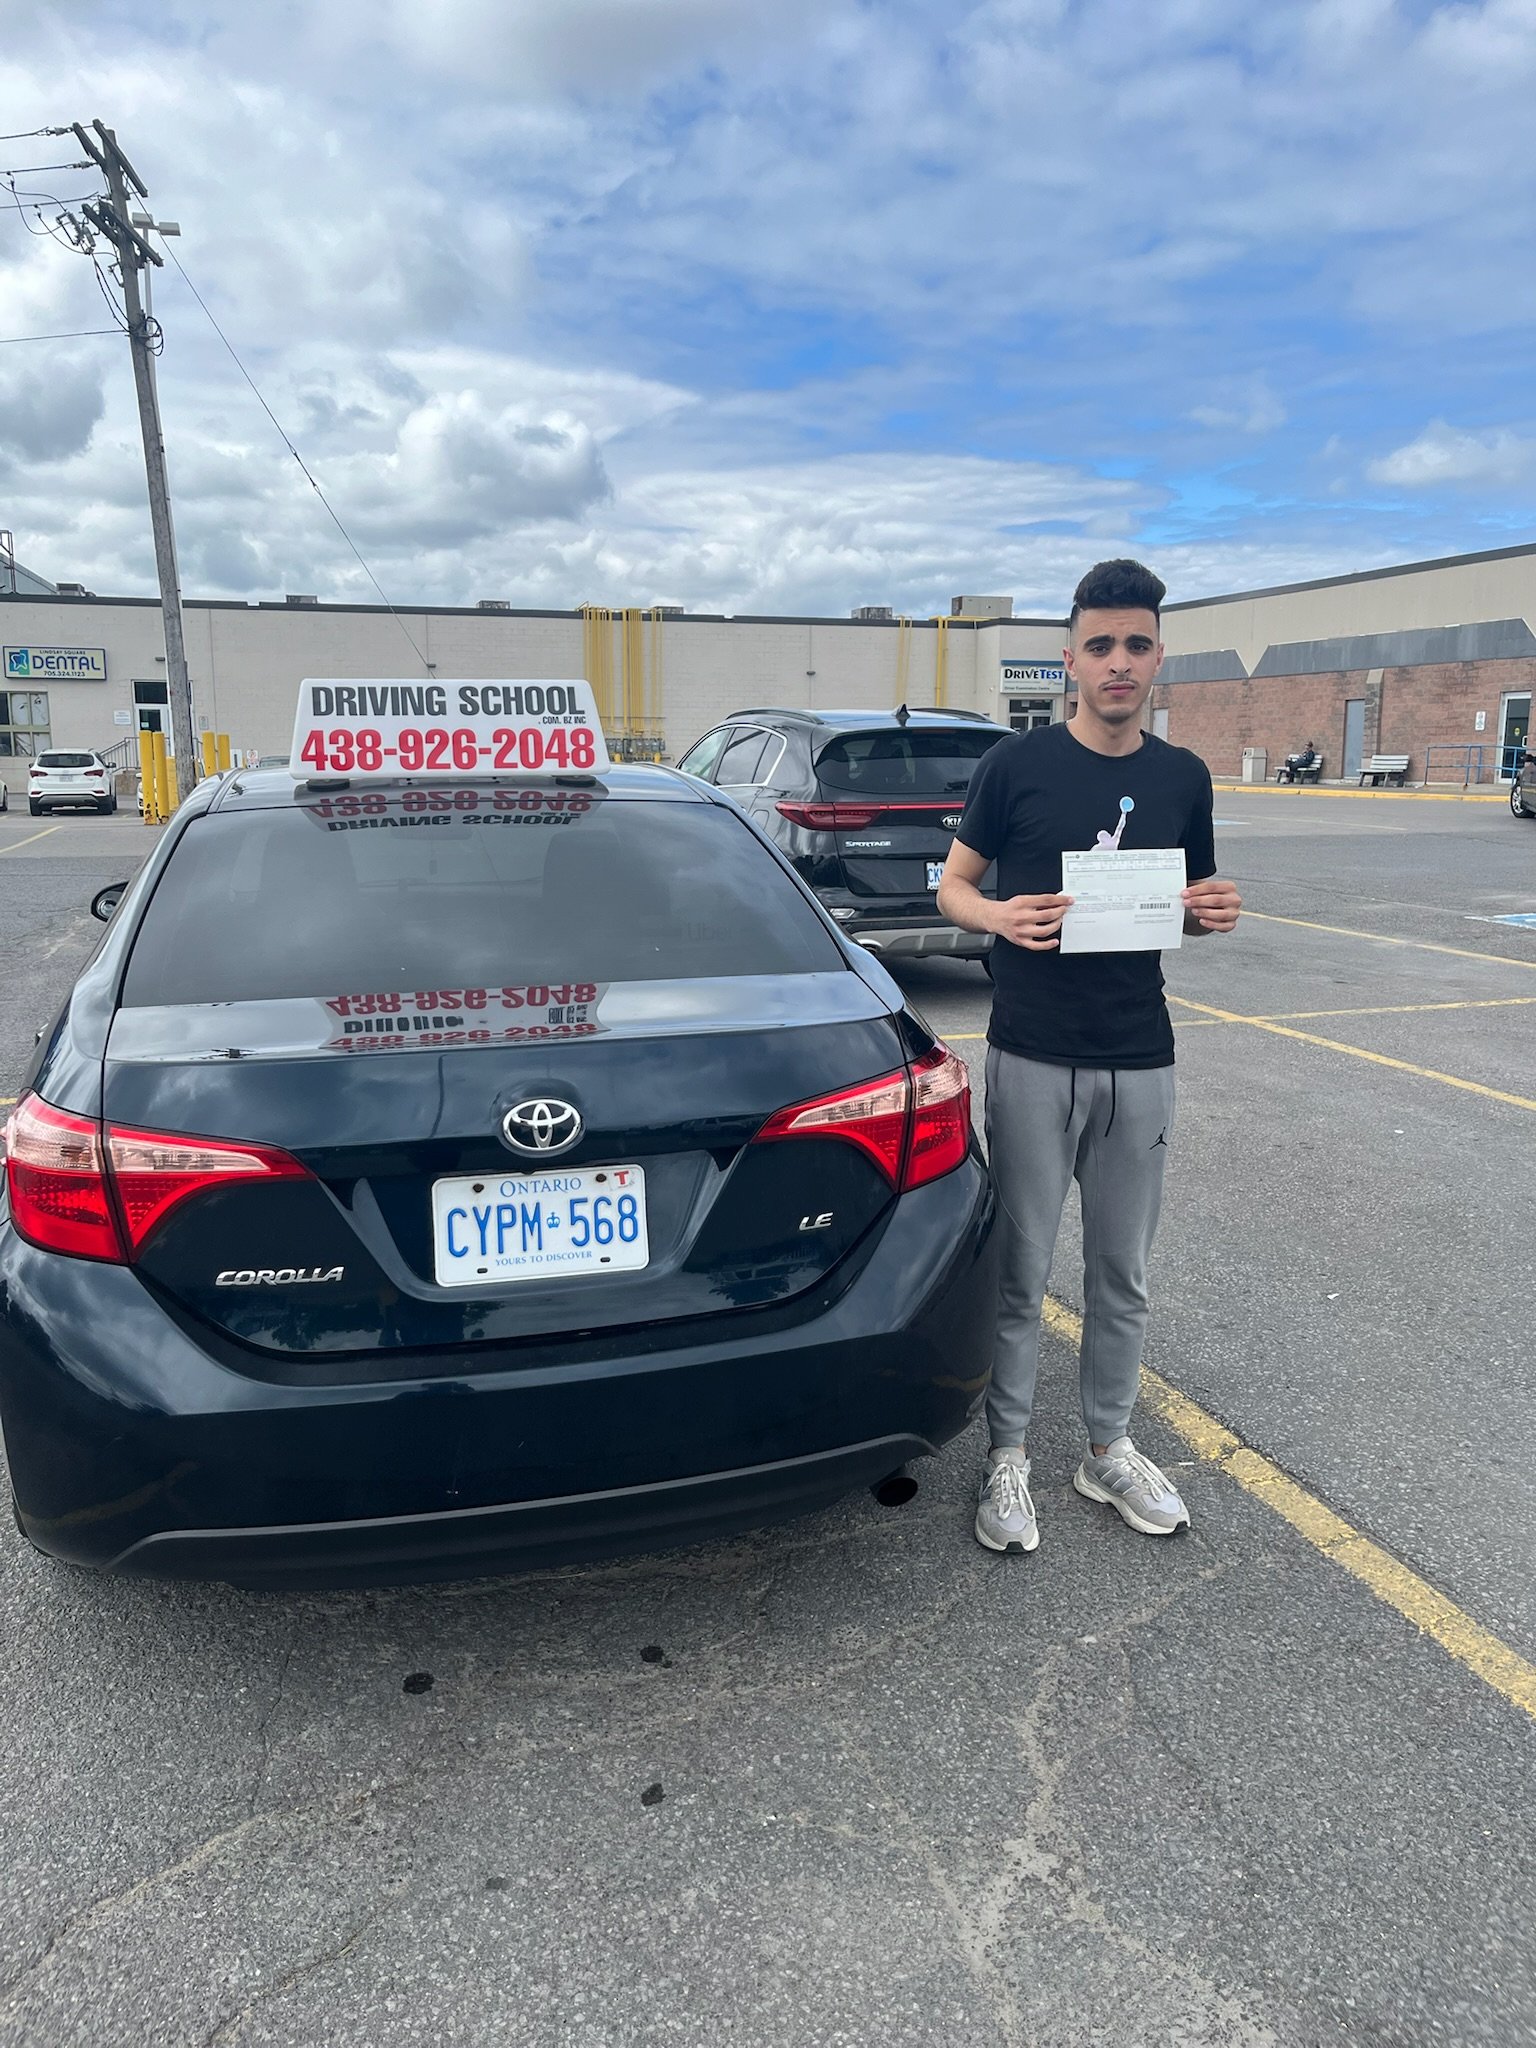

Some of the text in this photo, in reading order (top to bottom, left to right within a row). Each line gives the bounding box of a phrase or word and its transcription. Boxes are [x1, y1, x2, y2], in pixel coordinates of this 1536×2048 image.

[33, 656, 101, 670] DENTAL
[312, 686, 585, 716] DRIVING SCHOOL
[563, 716, 572, 724] BZ
[574, 716, 586, 724] INC
[301, 728, 595, 771] 438-926-2048
[500, 1170, 629, 1198] ONTARIO T
[447, 1194, 639, 1258] CYPM 568
[799, 1212, 833, 1230] LE
[495, 1250, 592, 1267] YOURS TO DISCOVER
[215, 1266, 345, 1286] COROLLA
